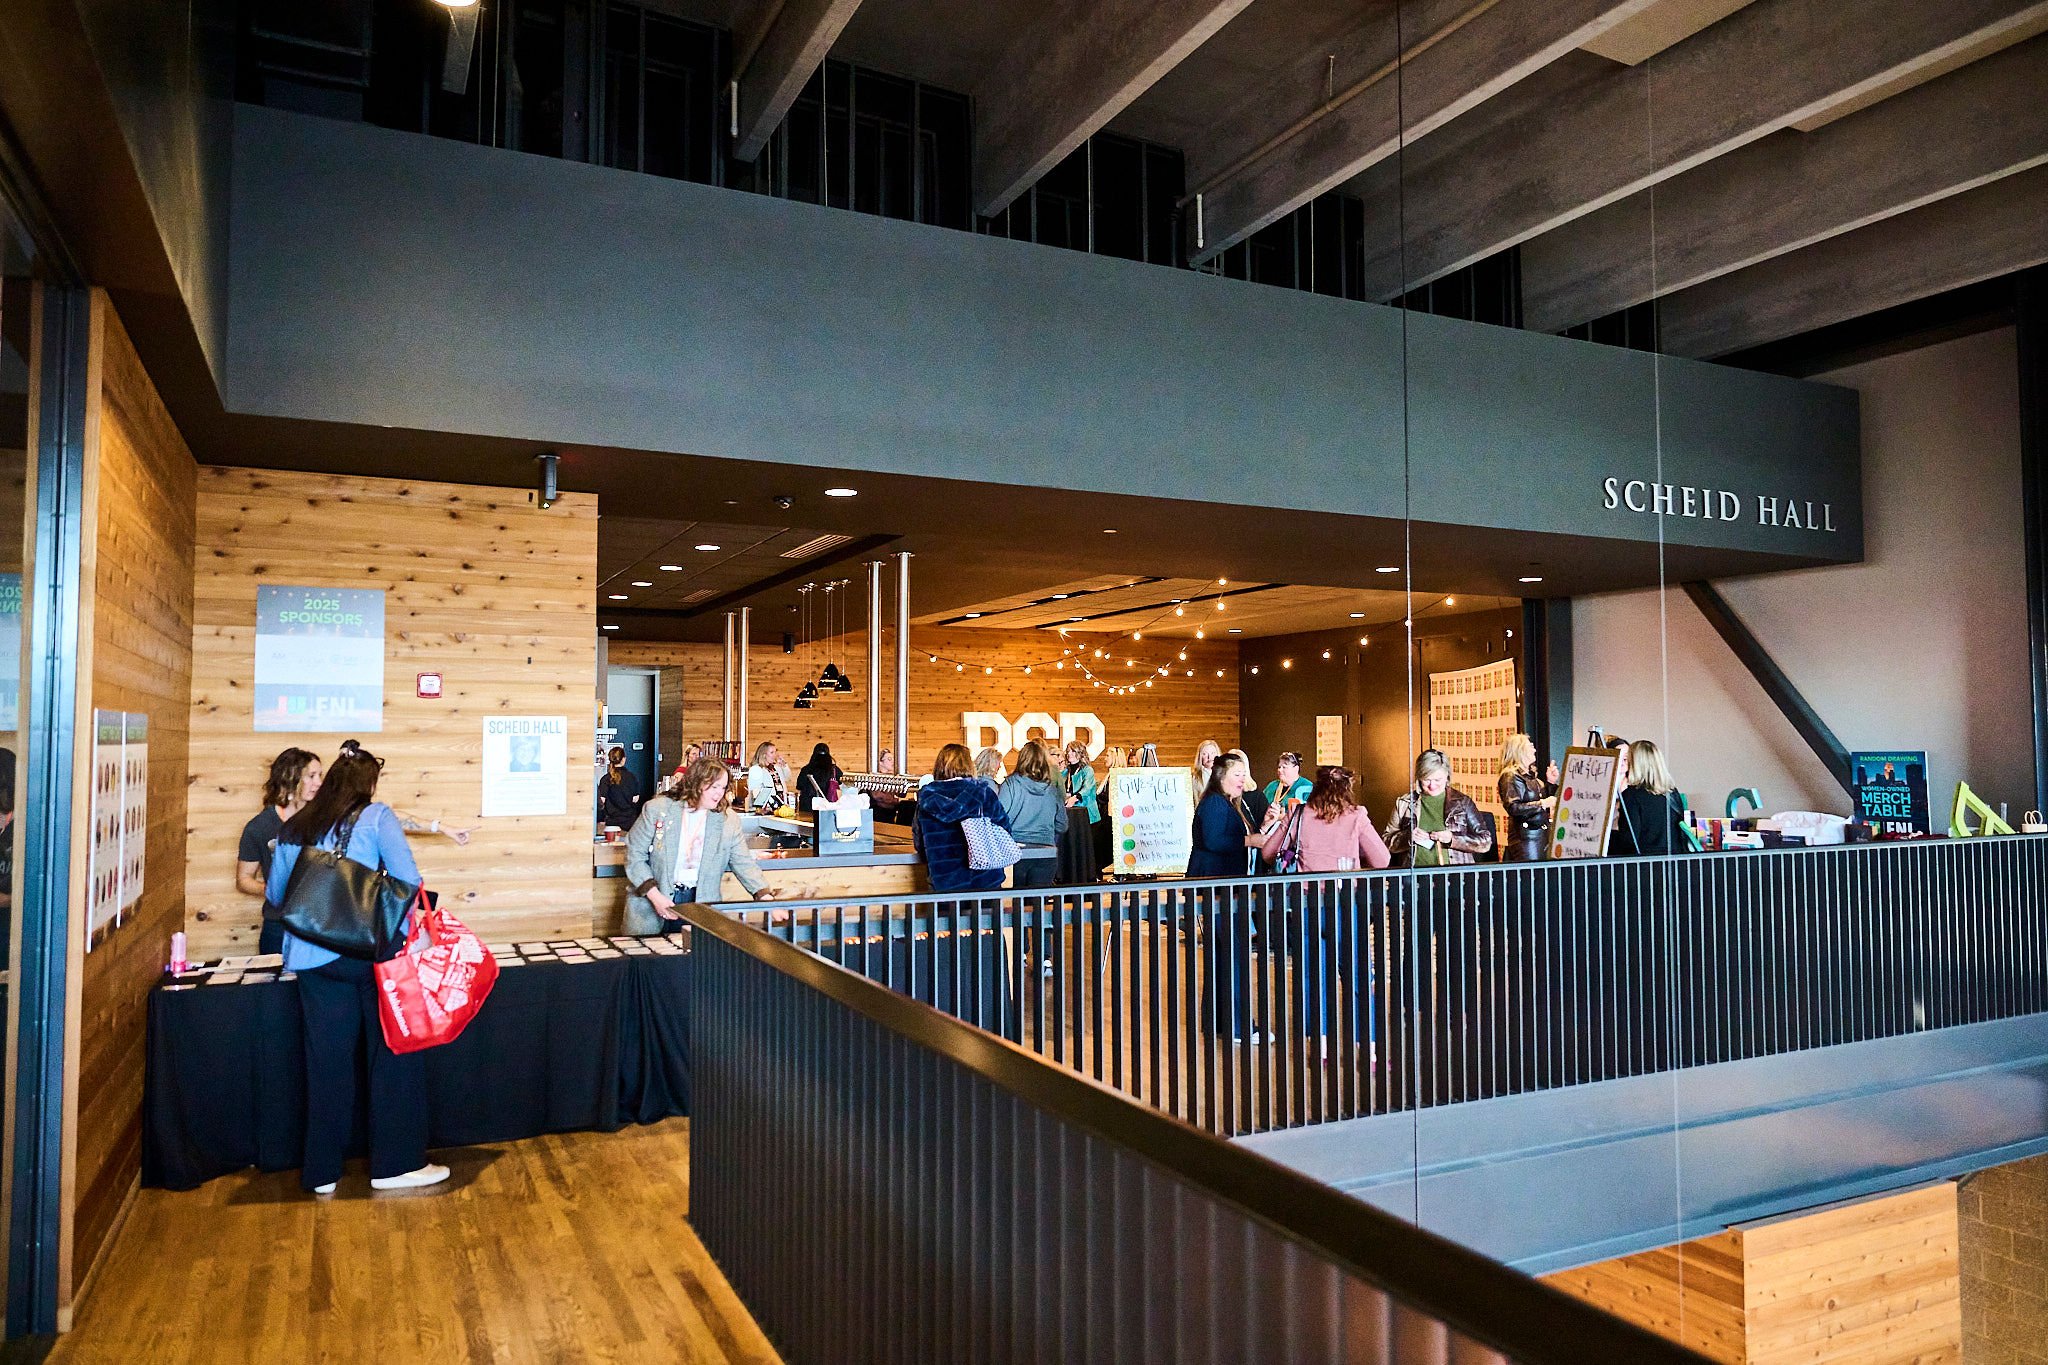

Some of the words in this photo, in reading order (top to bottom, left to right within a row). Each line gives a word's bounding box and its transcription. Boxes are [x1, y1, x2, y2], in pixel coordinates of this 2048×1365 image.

[1604, 477, 1741, 522] SCHEID
[1758, 495, 1836, 532] HALL
[304, 599, 340, 610] 2025
[280, 611, 363, 625] SPONSORS
[489, 720, 529, 733] SCHEID
[534, 720, 562, 733] HALL
[1861, 791, 1911, 804] MERCH
[1861, 803, 1911, 818] TABLE
